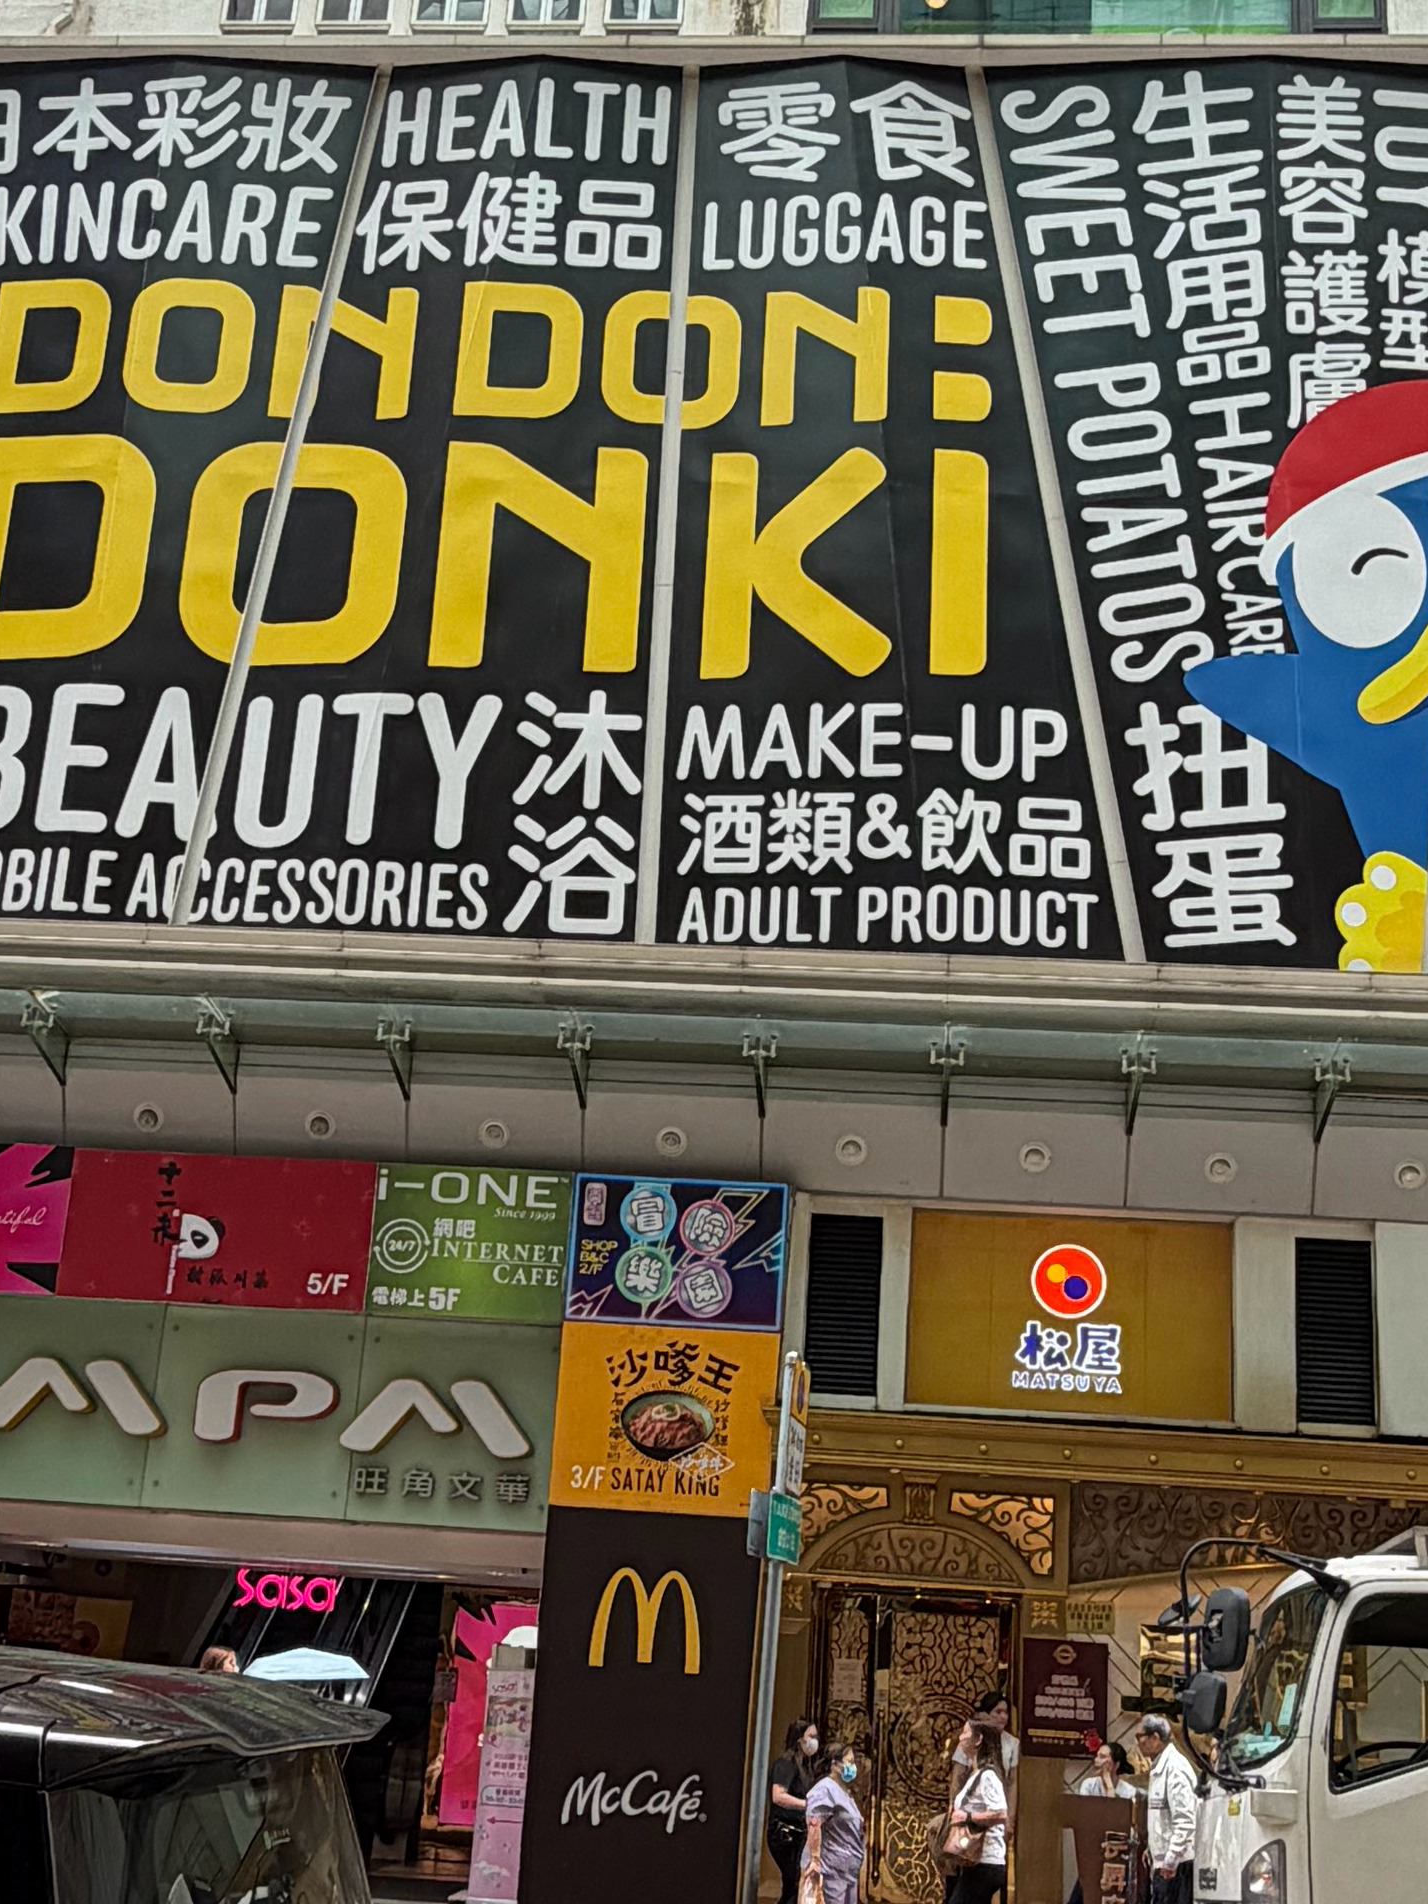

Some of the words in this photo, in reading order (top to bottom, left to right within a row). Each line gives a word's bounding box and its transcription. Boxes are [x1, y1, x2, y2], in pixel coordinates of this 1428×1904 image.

[377, 77, 672, 168] HEALTH
[717, 80, 975, 188] 零食
[356, 170, 662, 273] 保健品
[701, 192, 989, 271] LUGGAGE
[999, 86, 1152, 340] SWEET
[1131, 69, 1275, 386] 生活用品
[1274, 73, 1373, 430] 美容護膚
[1054, 359, 1215, 684] POTATOS
[676, 700, 1069, 785] MAKE-UP
[502, 689, 643, 937] 沐浴
[676, 788, 1092, 881] 酒類&飲品
[1125, 699, 1298, 949] 扭蛋
[125, 851, 489, 932] ACCESSORIES
[678, 884, 841, 945] ADULT
[856, 885, 1099, 951] PRODUCT
[377, 1168, 560, 1209] i-ONE
[493, 1206, 526, 1219] Since
[529, 1209, 557, 1222] 1999
[388, 1238, 417, 1252] 24/7
[431, 1237, 565, 1264] INTERNET
[492, 1264, 560, 1287] CAFE
[578, 1263, 604, 1276] 2/F
[579, 1252, 610, 1264] B&C
[580, 1238, 619, 1252] SHOP
[305, 1271, 350, 1296] 5/F
[1015, 1321, 1123, 1373] 松屋
[1012, 1369, 1124, 1396] MATSUYA
[352, 1466, 531, 1505] 旺角文華
[570, 1464, 606, 1491] 3/F
[610, 1467, 669, 1493] SATAY
[673, 1469, 721, 1497] KING
[561, 1769, 702, 1834] McCafé
